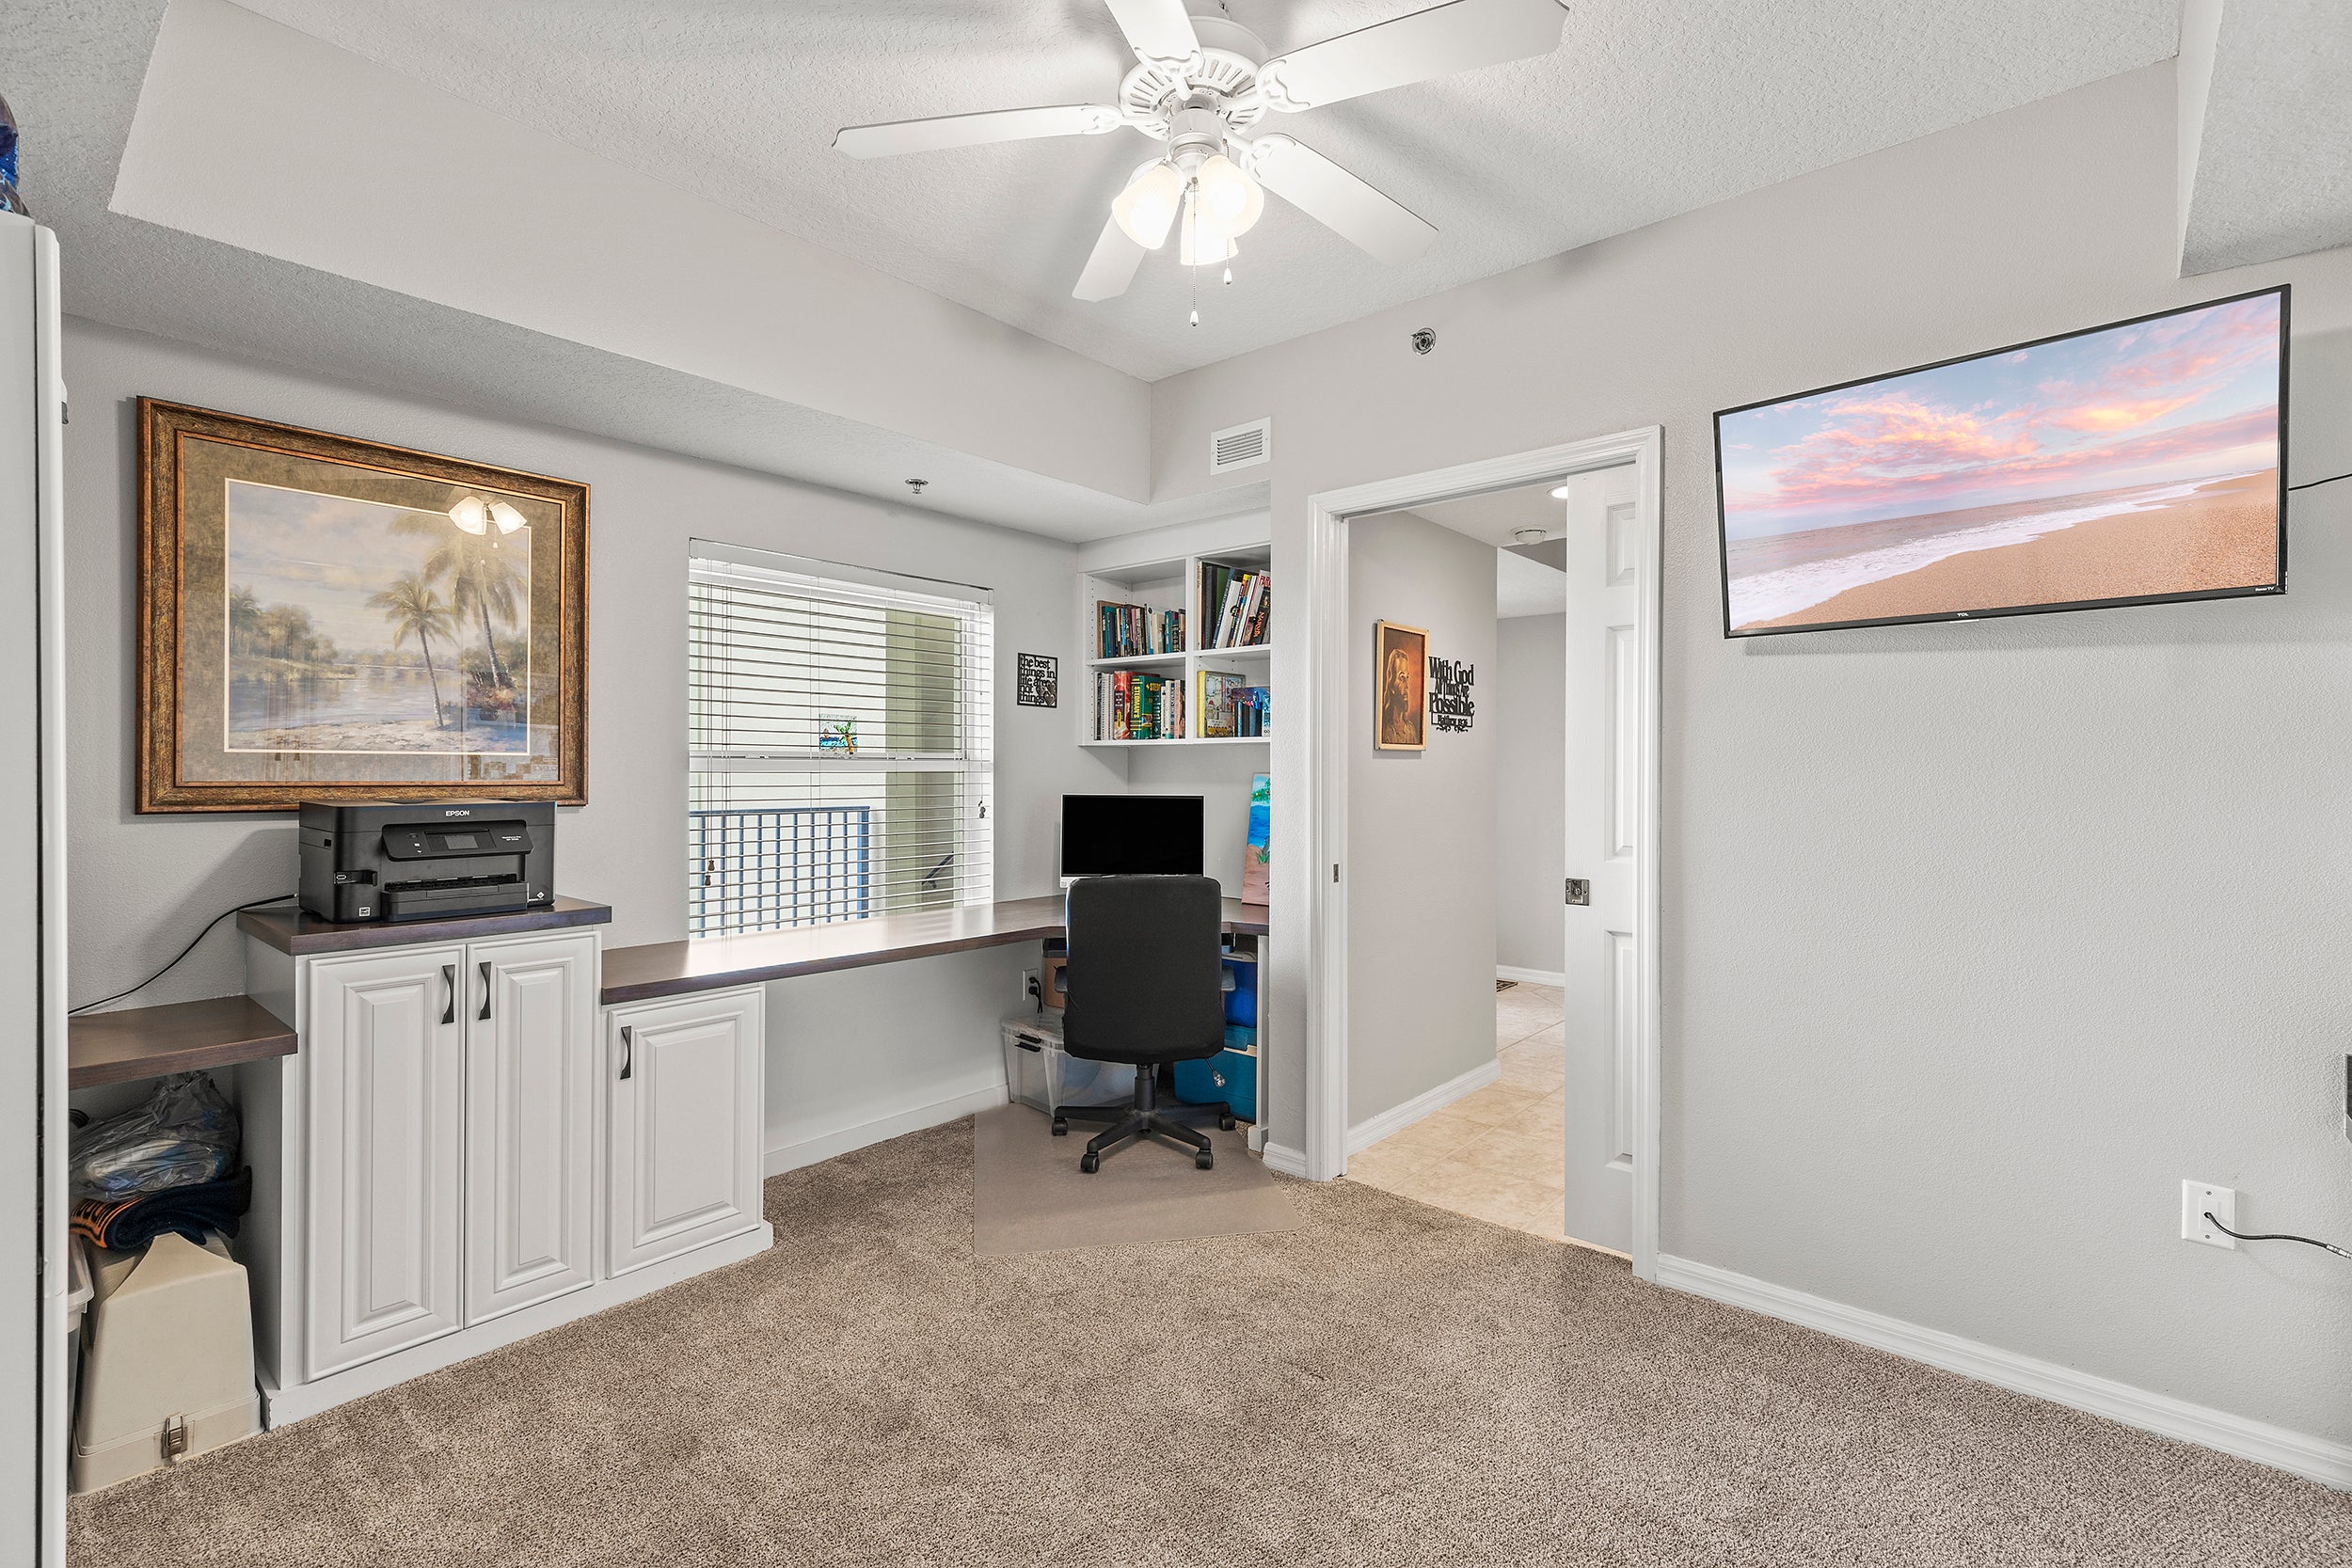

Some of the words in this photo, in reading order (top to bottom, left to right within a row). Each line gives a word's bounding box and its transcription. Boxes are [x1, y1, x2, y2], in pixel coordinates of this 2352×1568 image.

[1034, 657, 1051, 670] best
[1428, 656, 1453, 681] With
[1454, 660, 1474, 686] God
[1046, 669, 1056, 678] in
[1428, 692, 1475, 717] Possible
